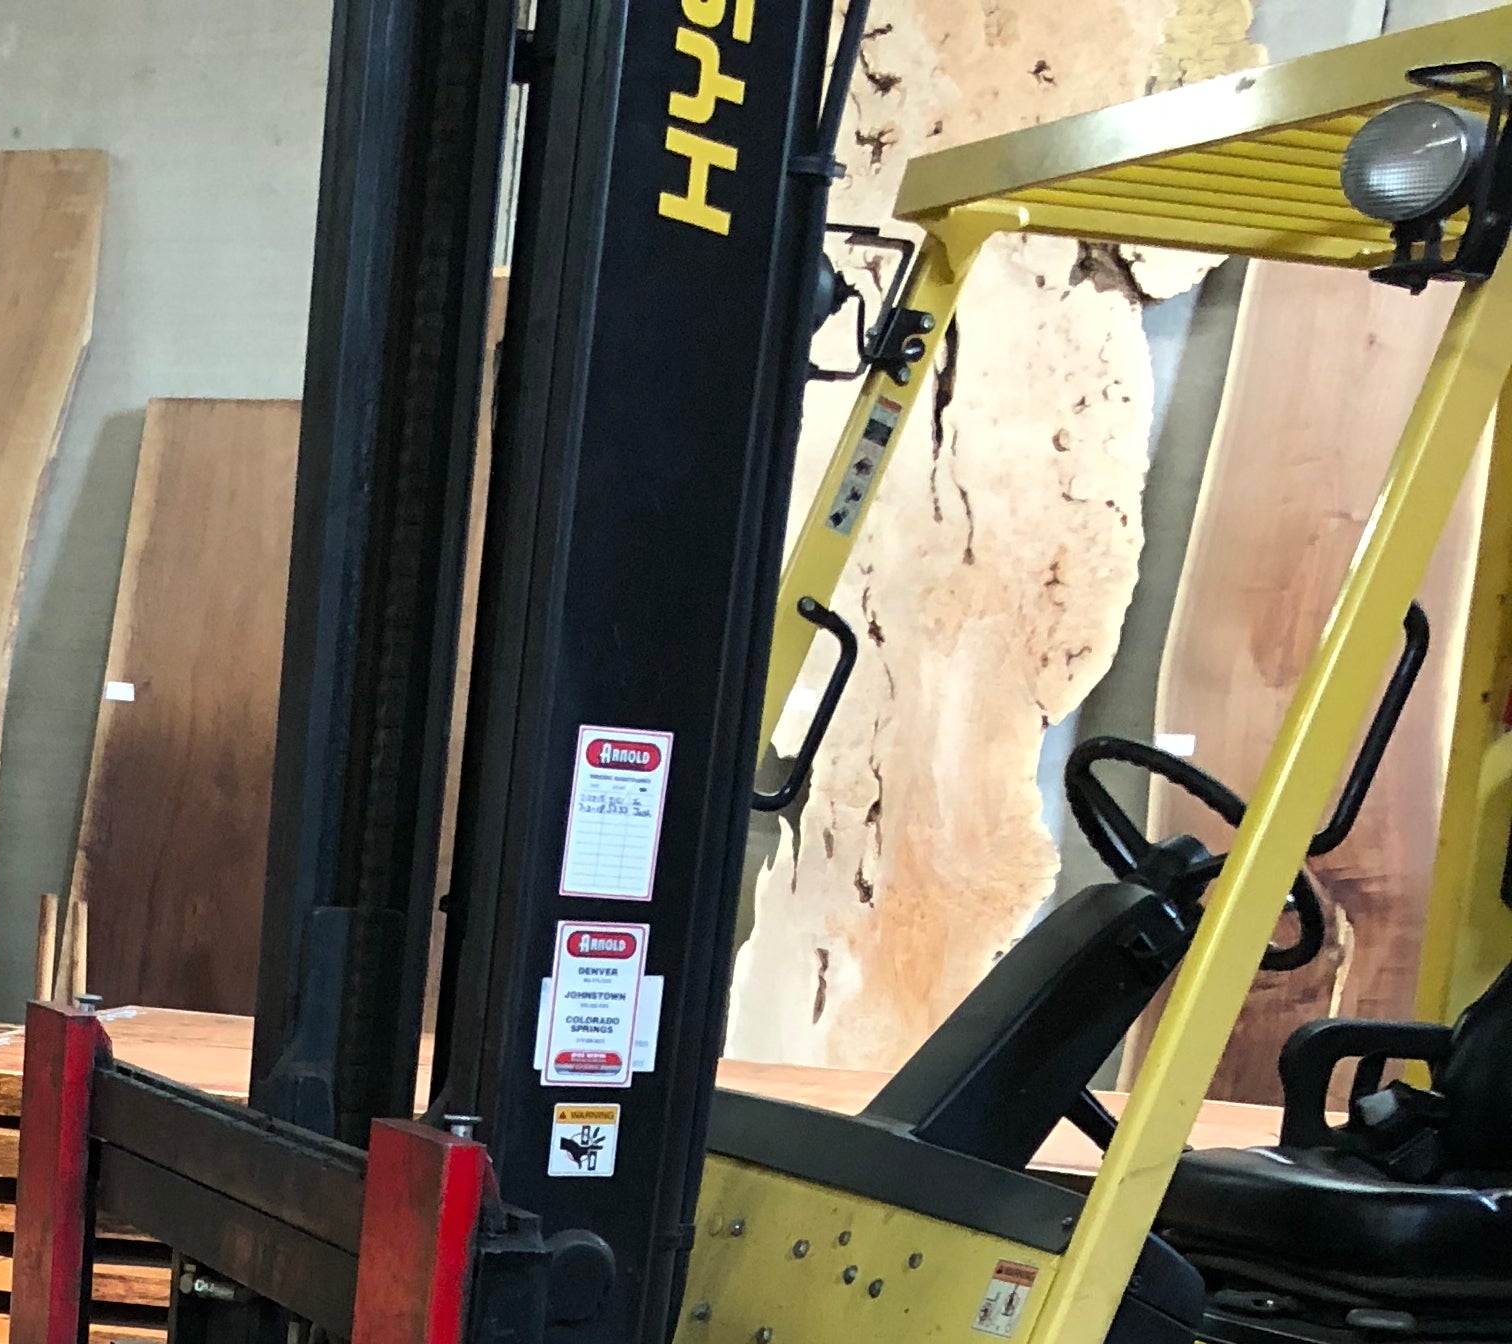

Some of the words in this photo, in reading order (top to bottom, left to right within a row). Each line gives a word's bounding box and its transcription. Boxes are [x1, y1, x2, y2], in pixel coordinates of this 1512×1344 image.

[578, 967, 618, 976] DENVER
[564, 990, 626, 1001] JOHNSTOWN
[566, 1016, 620, 1025] COLORADO
[571, 1025, 613, 1034] SPRINGS
[570, 1111, 614, 1120] WARNING
